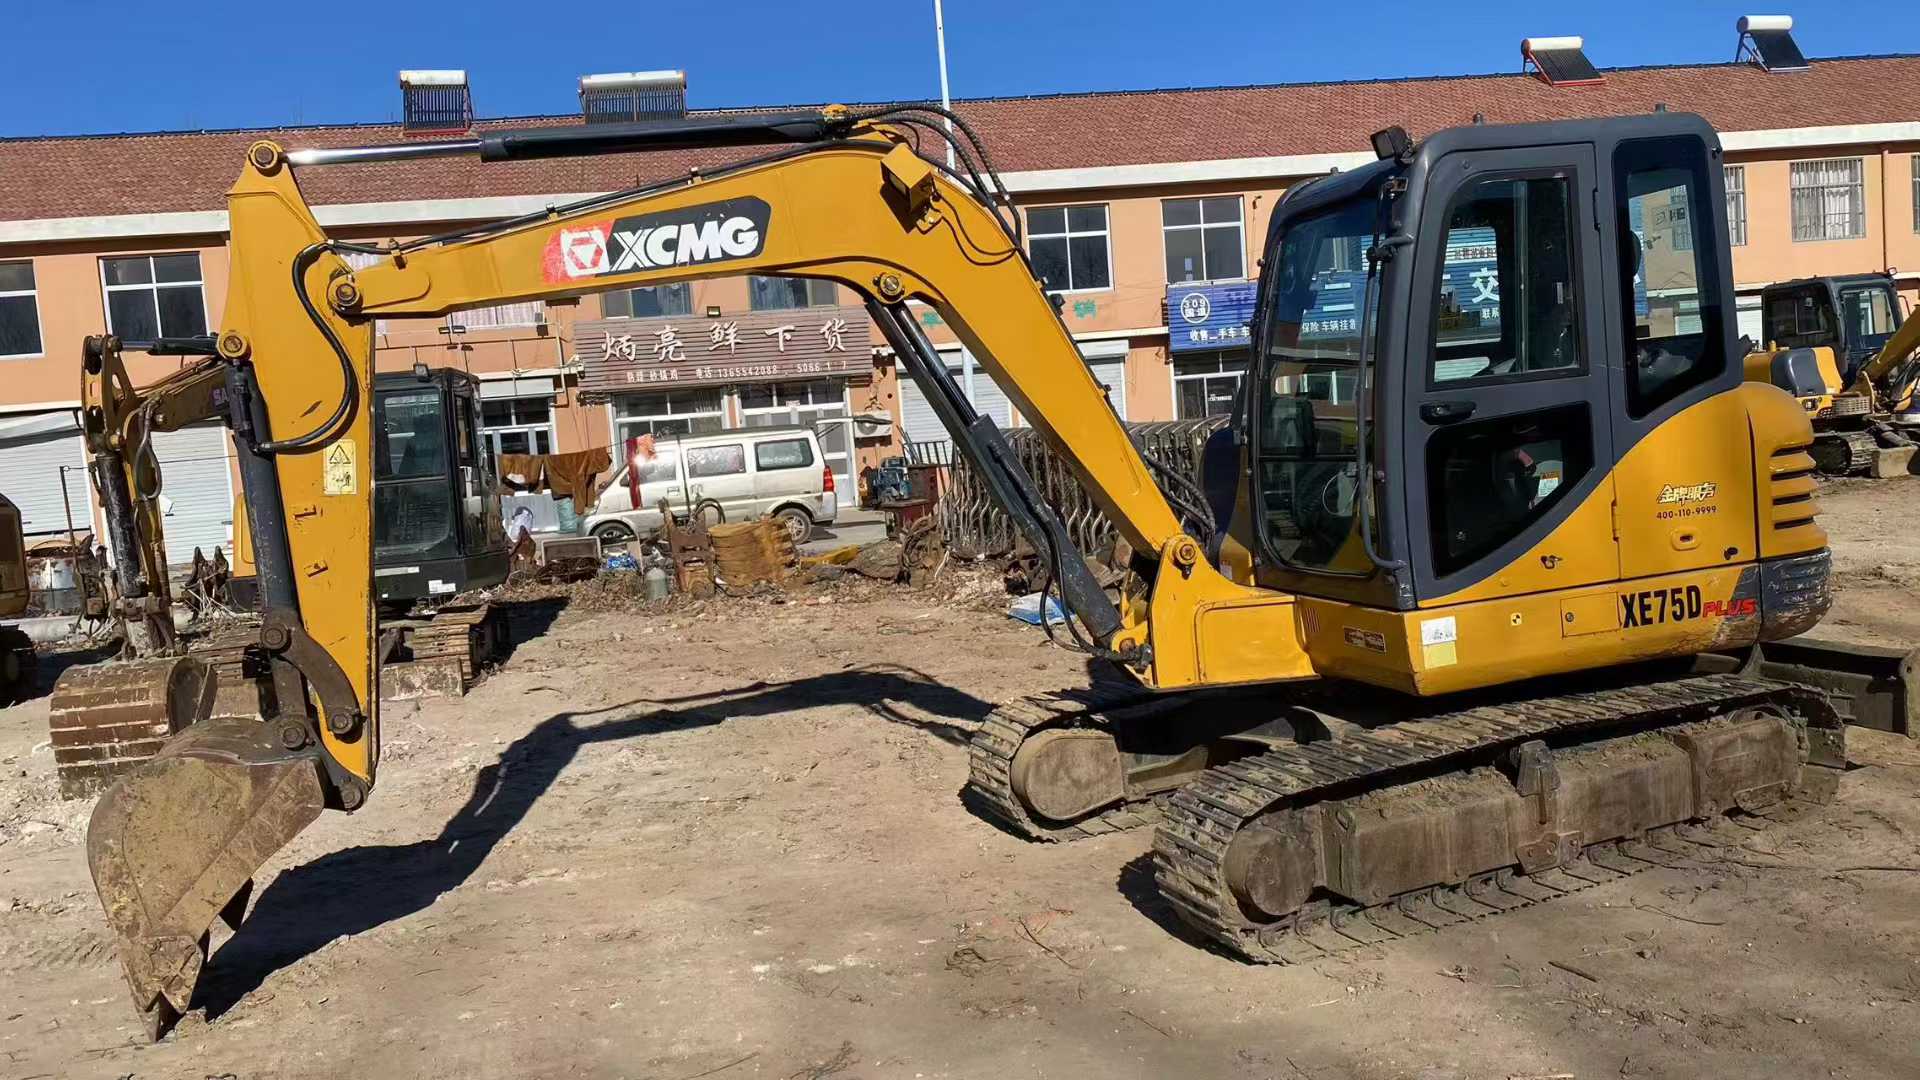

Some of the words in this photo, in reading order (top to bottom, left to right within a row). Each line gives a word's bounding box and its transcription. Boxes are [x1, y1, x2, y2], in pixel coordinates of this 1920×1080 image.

[611, 217, 758, 271] XCMG
[1469, 267, 1499, 303] 交
[1183, 298, 1205, 308] 309
[601, 318, 848, 362] 炳亮鲜下货
[696, 367, 712, 378] 电话
[1657, 482, 1717, 505] 金牌服务
[1657, 506, 1717, 520] 400-110-9999
[1621, 585, 1701, 628] XE75D
[1702, 599, 1757, 618] PLUS
